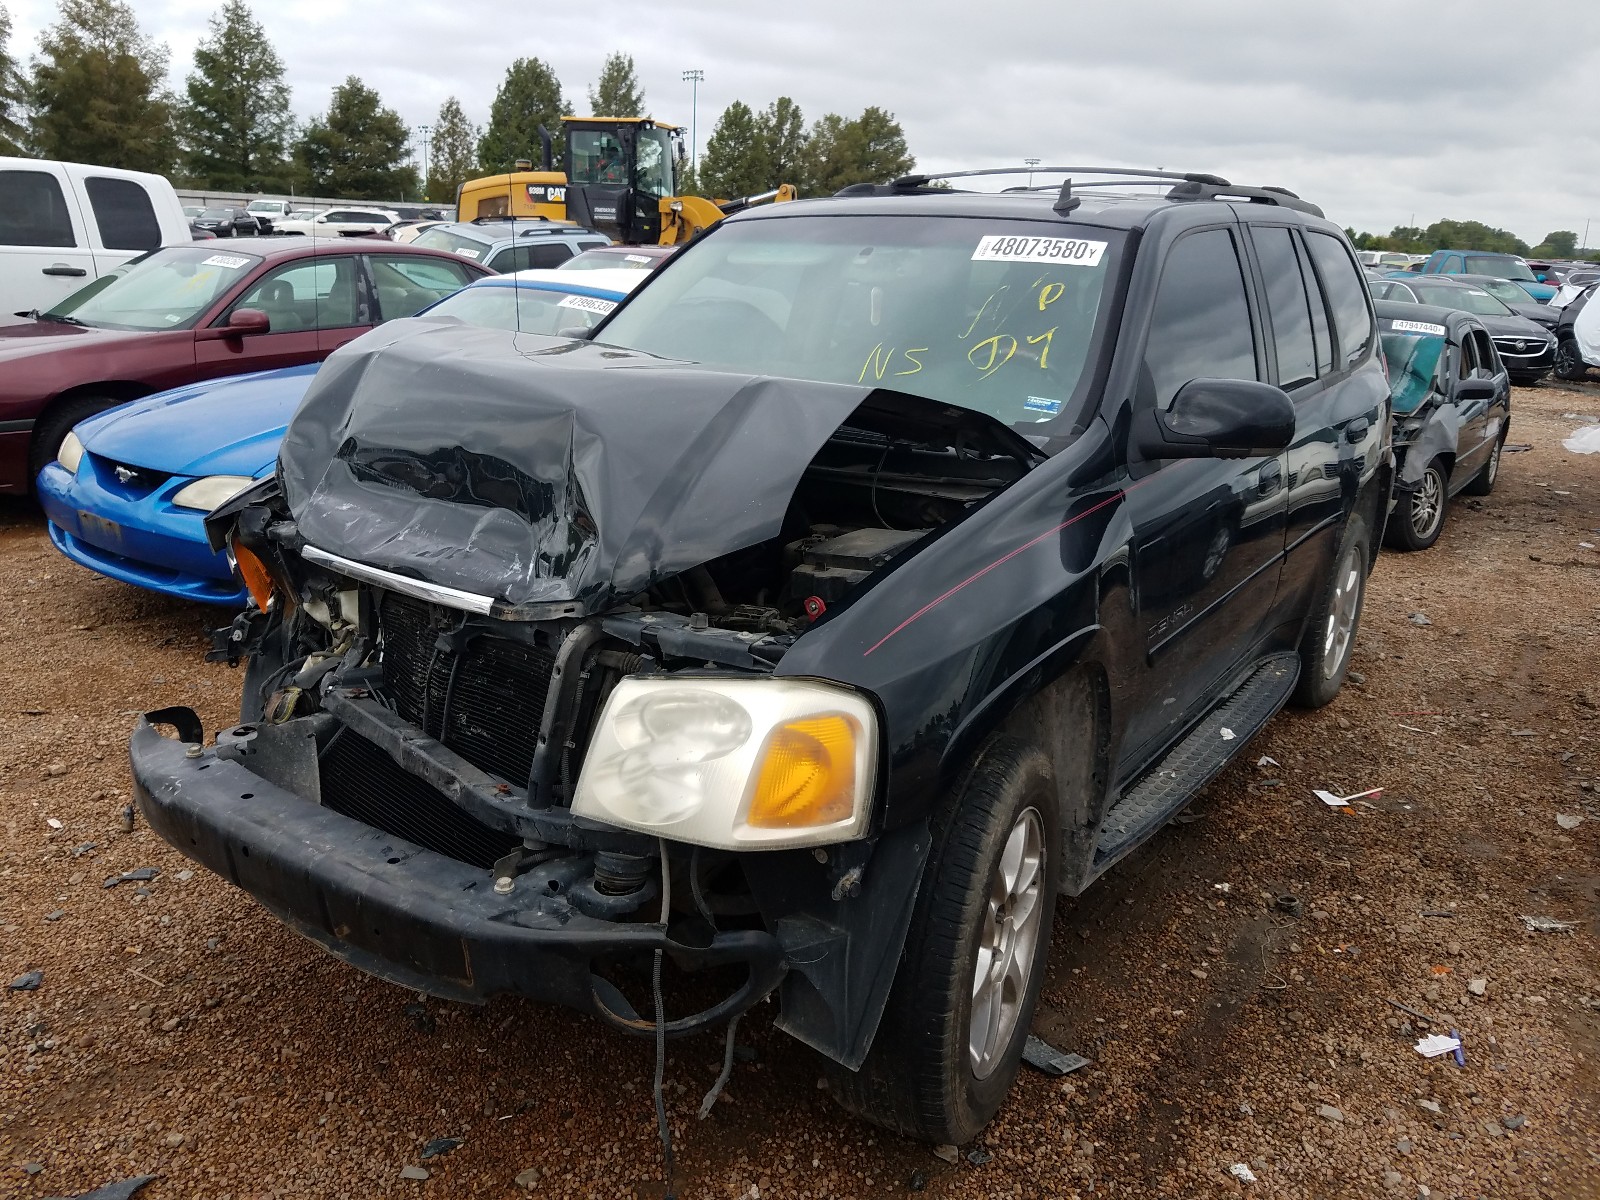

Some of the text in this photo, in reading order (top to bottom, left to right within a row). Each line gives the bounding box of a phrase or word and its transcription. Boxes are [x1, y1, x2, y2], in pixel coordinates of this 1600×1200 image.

[547, 187, 567, 201] CAT
[990, 237, 1089, 260] 48073580
[568, 297, 615, 312] 47996330
[1398, 321, 1438, 333] 47947440
